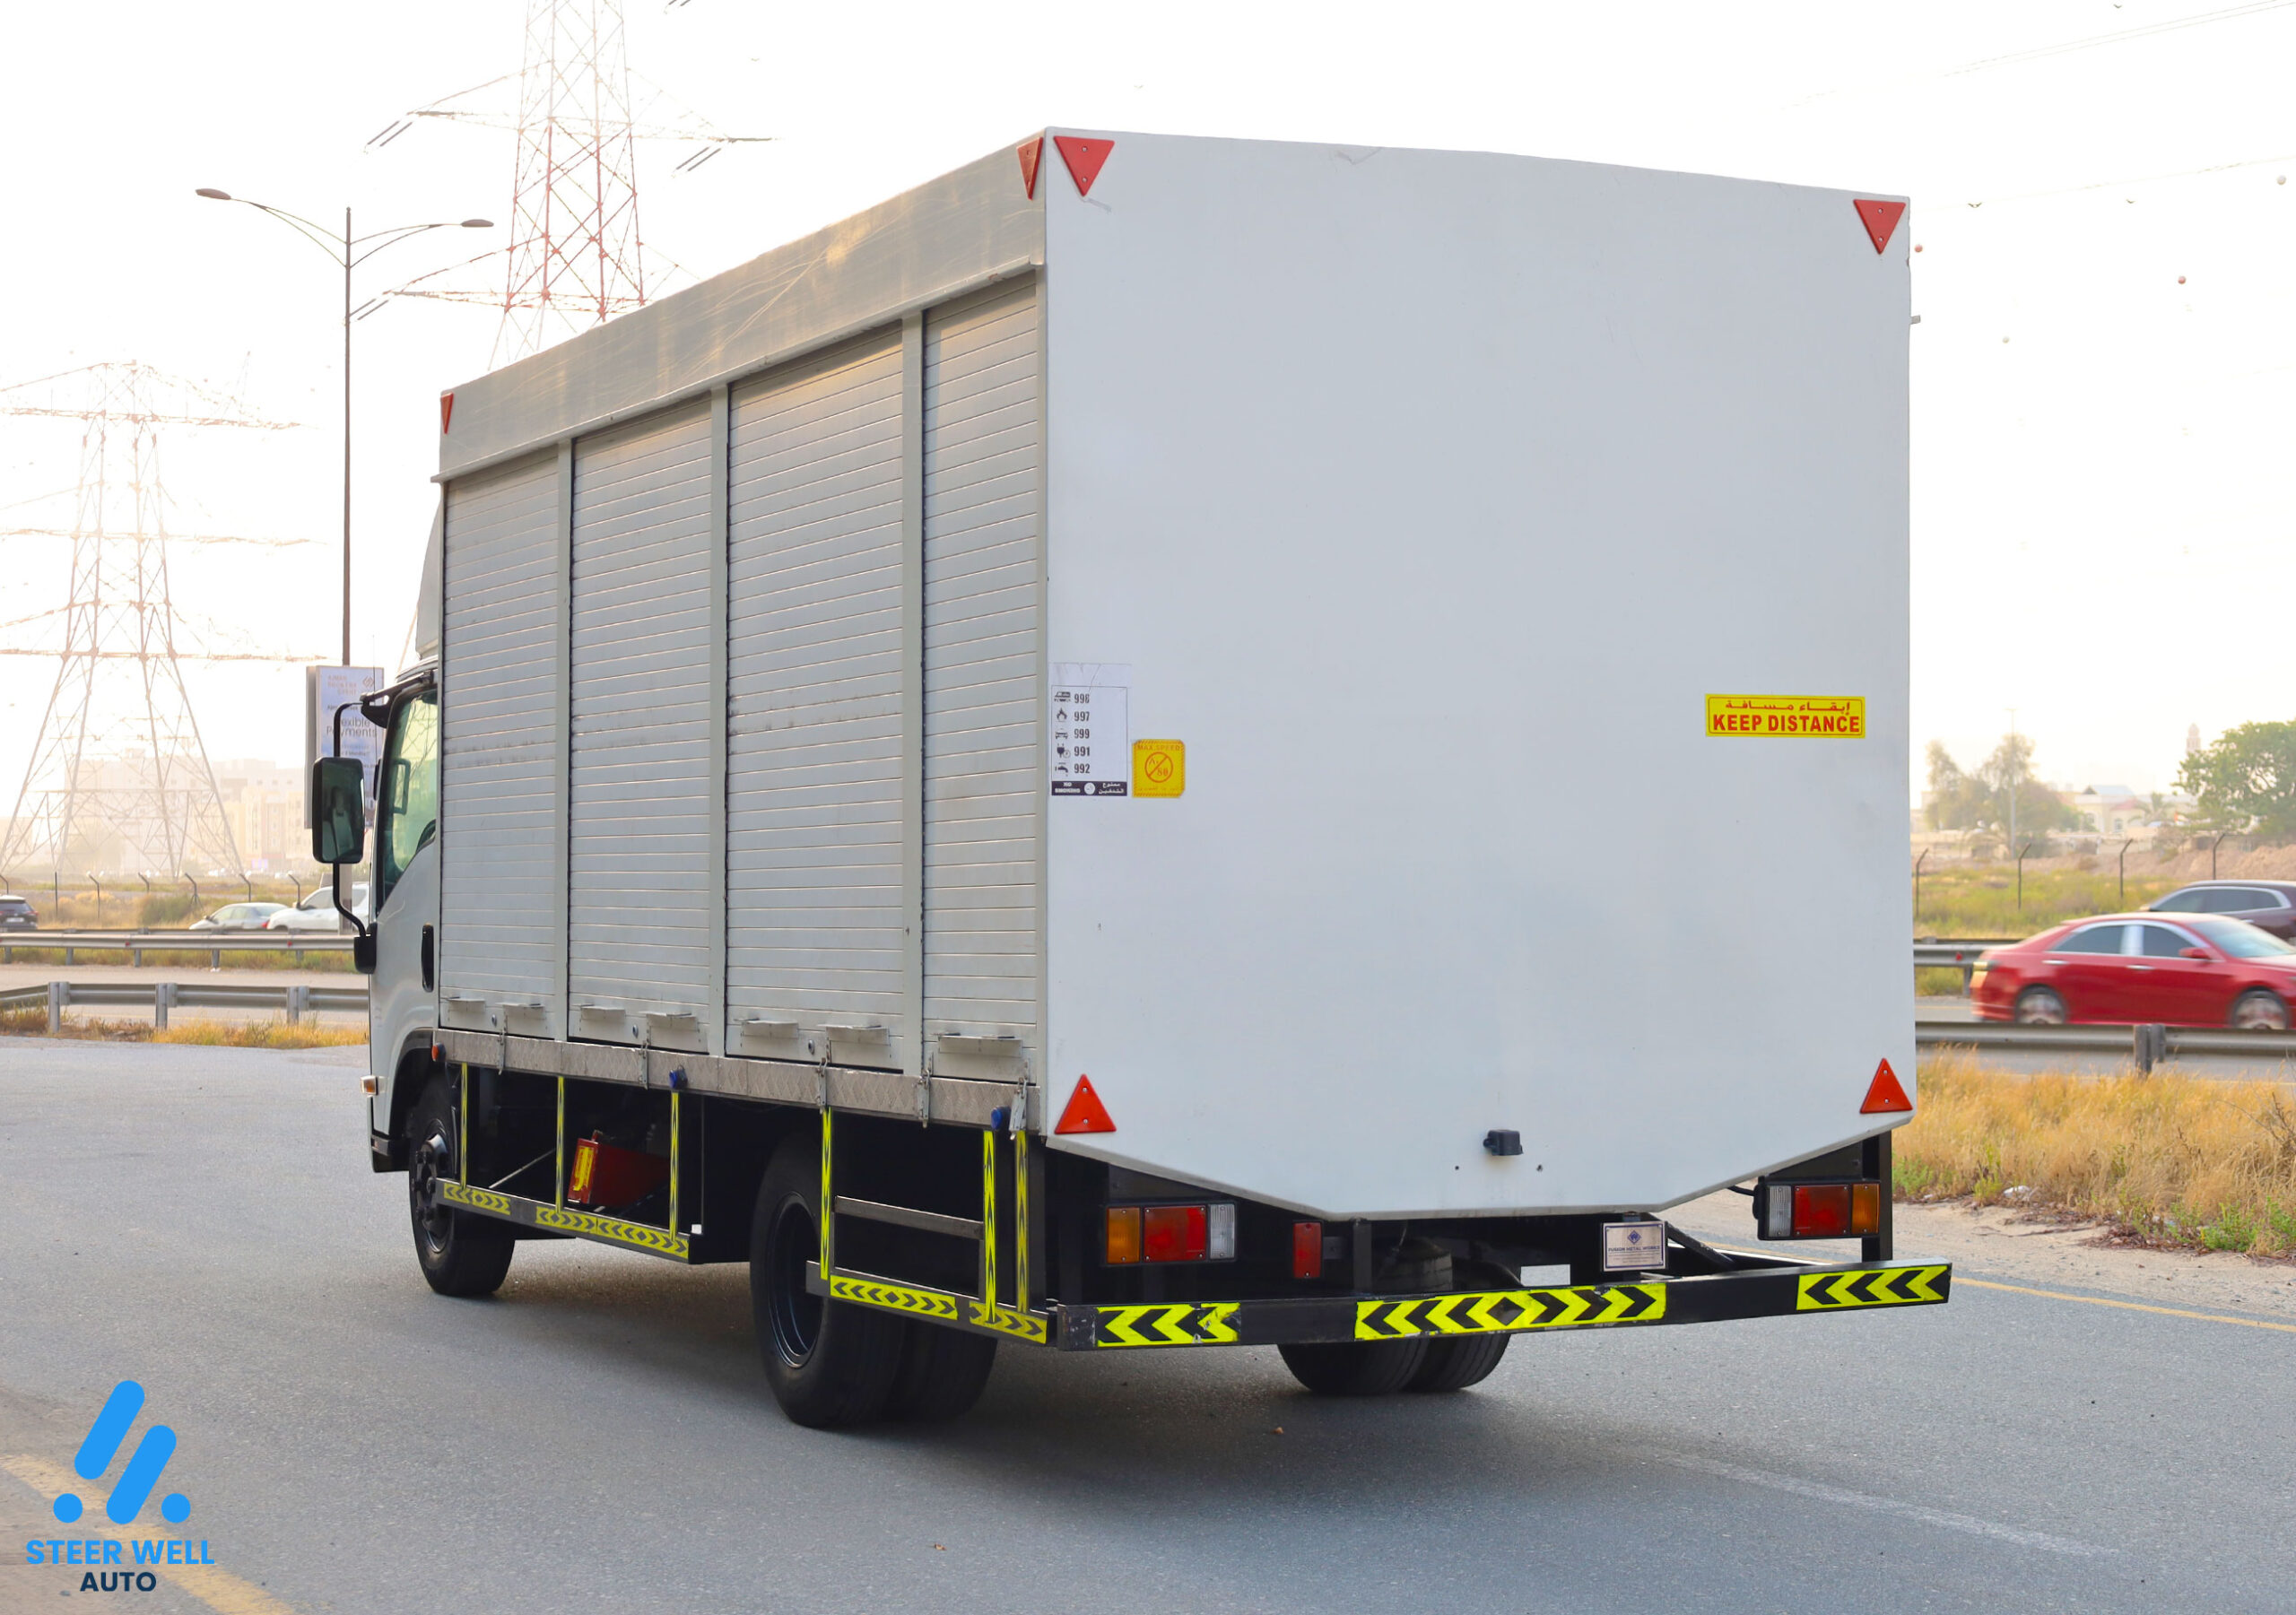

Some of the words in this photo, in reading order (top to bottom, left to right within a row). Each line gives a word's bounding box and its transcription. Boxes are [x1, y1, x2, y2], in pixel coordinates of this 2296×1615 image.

[1726, 699, 1794, 711] مسافة
[1799, 701, 1850, 716] إبقاء
[1074, 711, 1090, 722] 997
[1713, 714, 1762, 731] KEEP
[1768, 715, 1859, 732] DISTANCE
[326, 725, 378, 737] Pyments
[1074, 728, 1090, 739] 999
[1074, 746, 1090, 756] 991
[1074, 764, 1090, 774] 992
